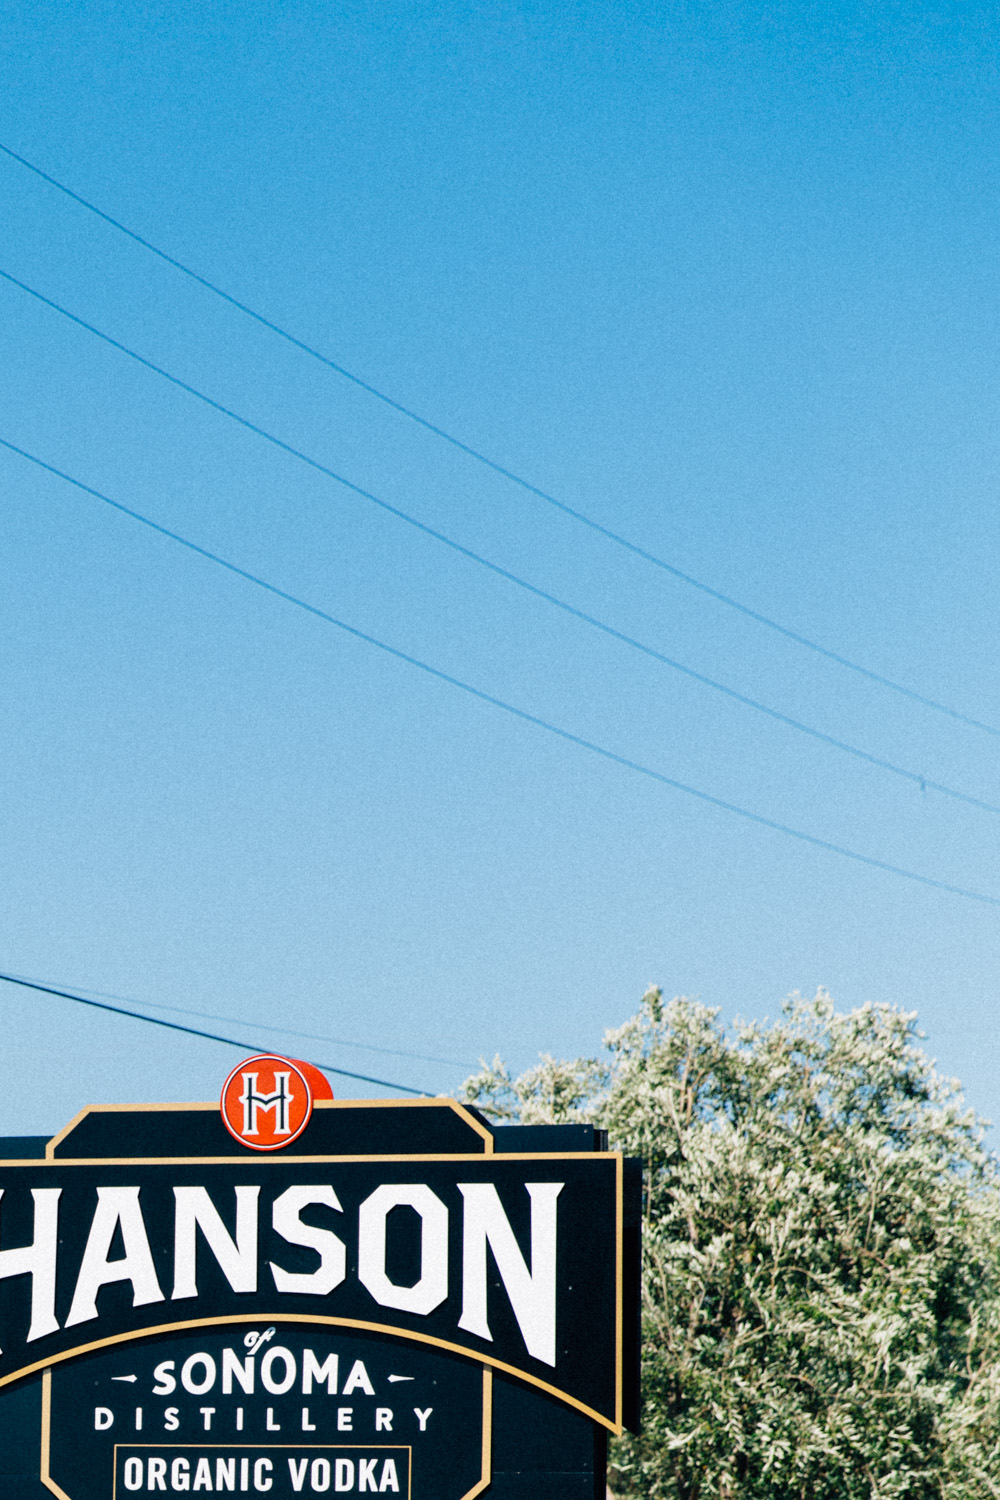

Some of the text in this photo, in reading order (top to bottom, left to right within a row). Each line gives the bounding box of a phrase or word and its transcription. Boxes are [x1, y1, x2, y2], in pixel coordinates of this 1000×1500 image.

[239, 1070, 294, 1137] H
[243, 1326, 276, 1355] of
[151, 1346, 376, 1396] SONOMA
[94, 1406, 434, 1432] DISTILLERY
[124, 1456, 400, 1493] ORGANIC VODKA
